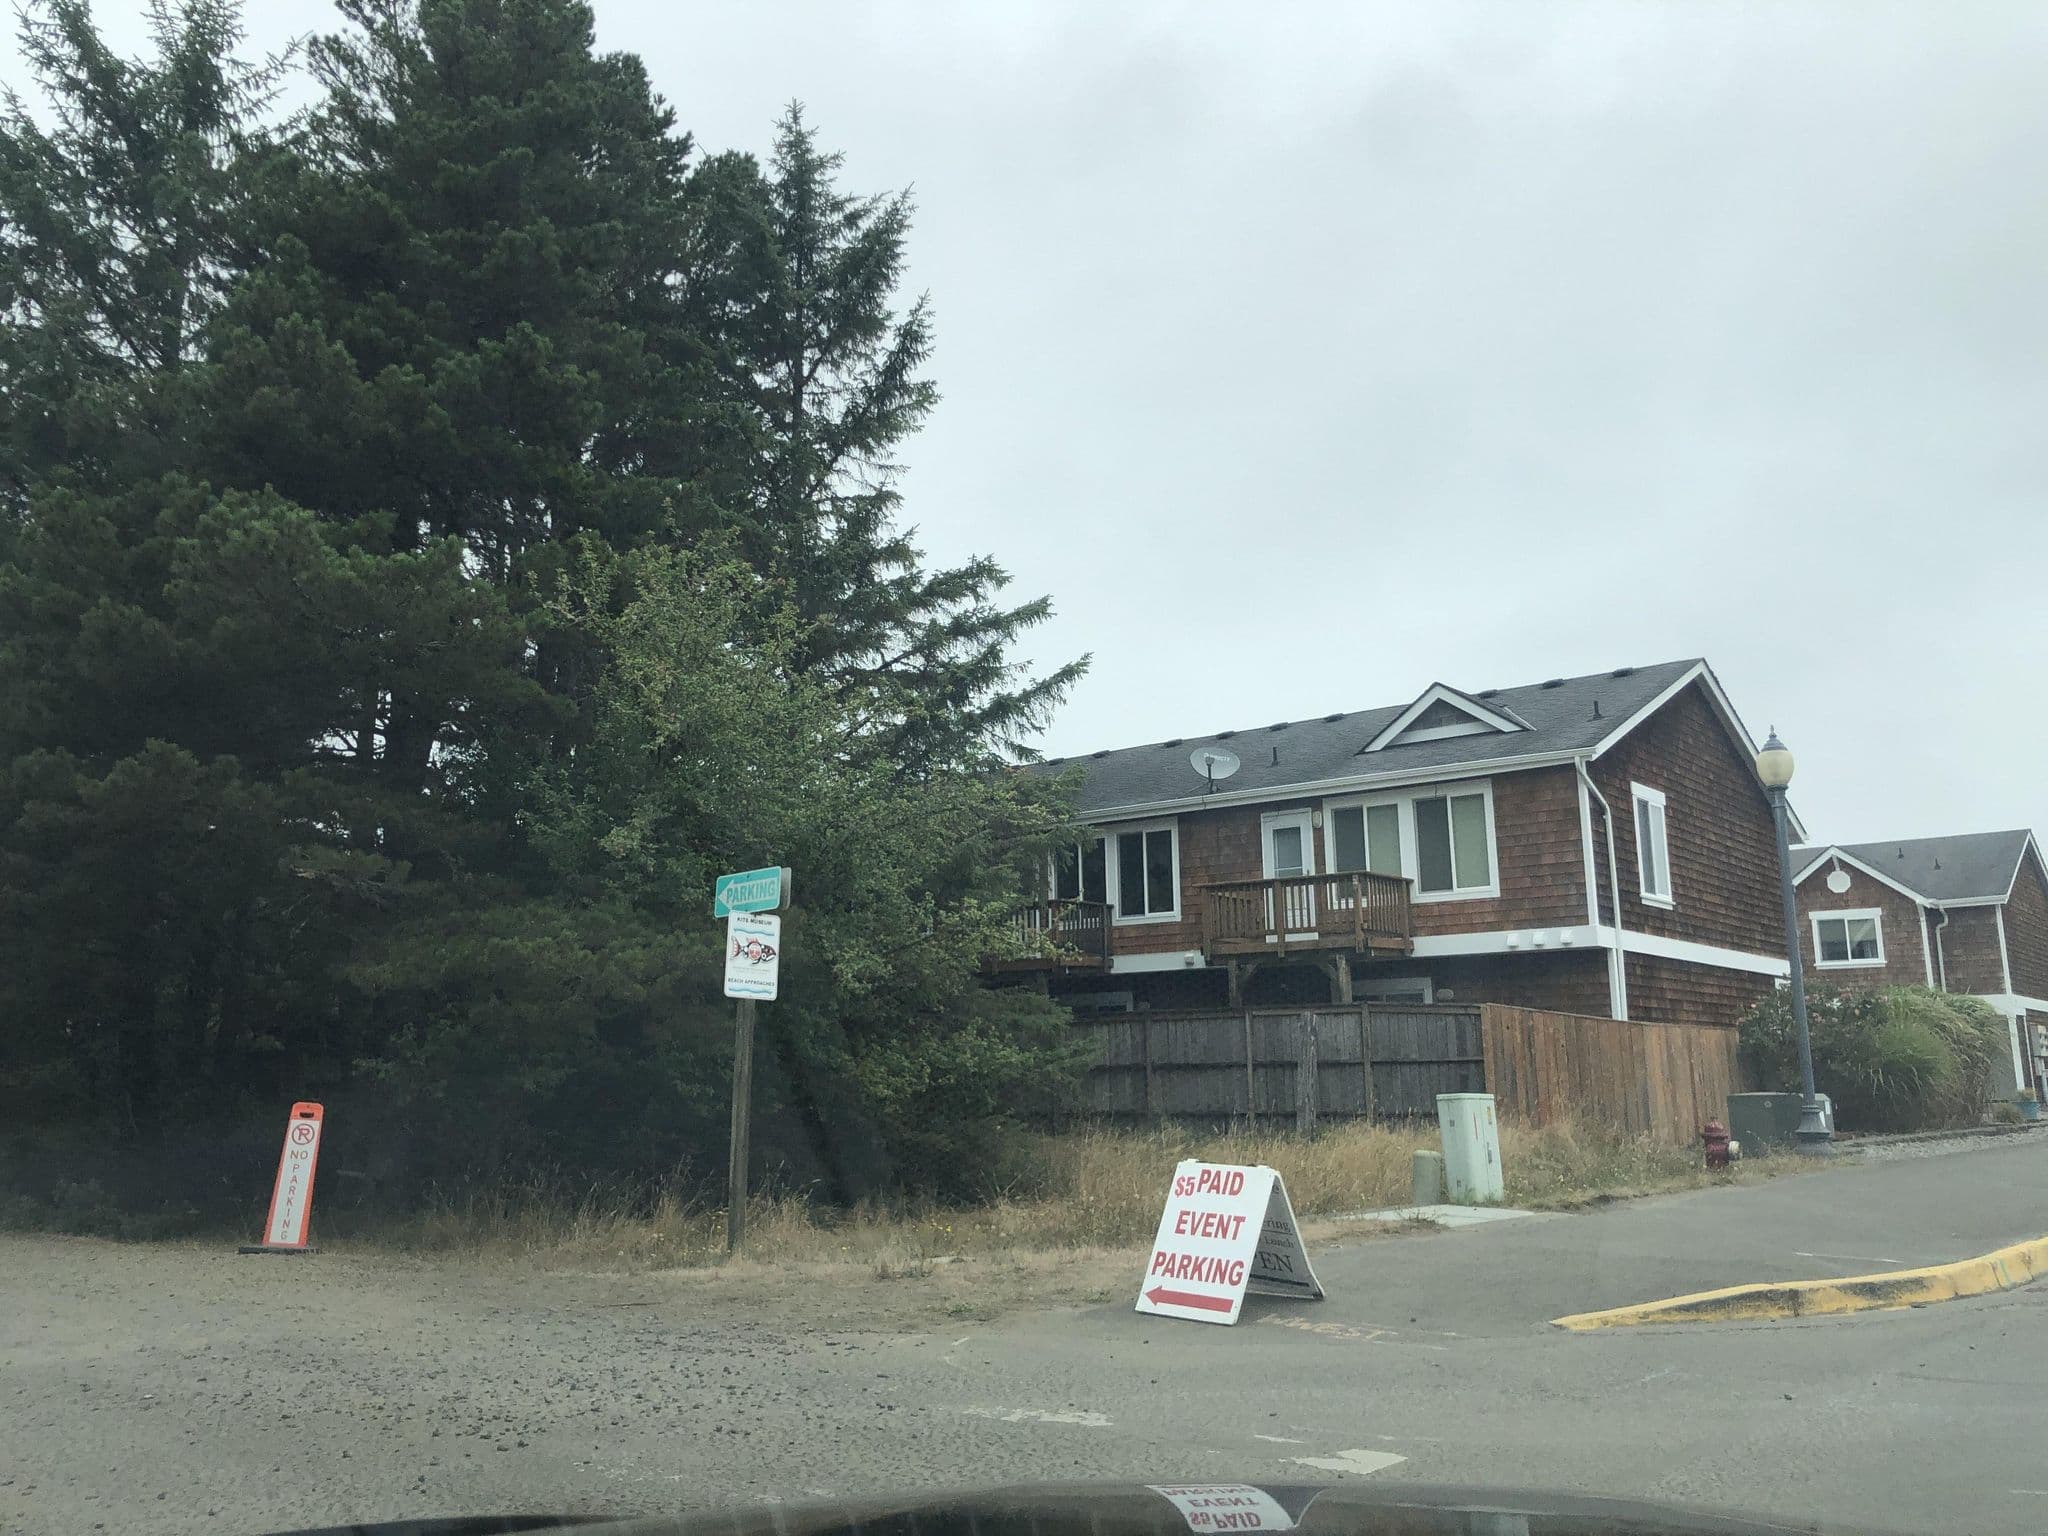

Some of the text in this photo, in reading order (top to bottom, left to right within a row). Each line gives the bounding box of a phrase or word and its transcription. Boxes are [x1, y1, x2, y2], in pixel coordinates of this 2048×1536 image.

[726, 881, 776, 903] PARKING
[745, 978, 775, 987] APPROACHES
[290, 1151, 309, 1160] NO
[1174, 1175, 1196, 1198] $5
[1197, 1169, 1245, 1196] PAID
[280, 1163, 300, 1240] PARKING
[1174, 1210, 1247, 1240] EVENT
[1151, 1251, 1245, 1286] PARKING
[1254, 1251, 1293, 1273] EN
